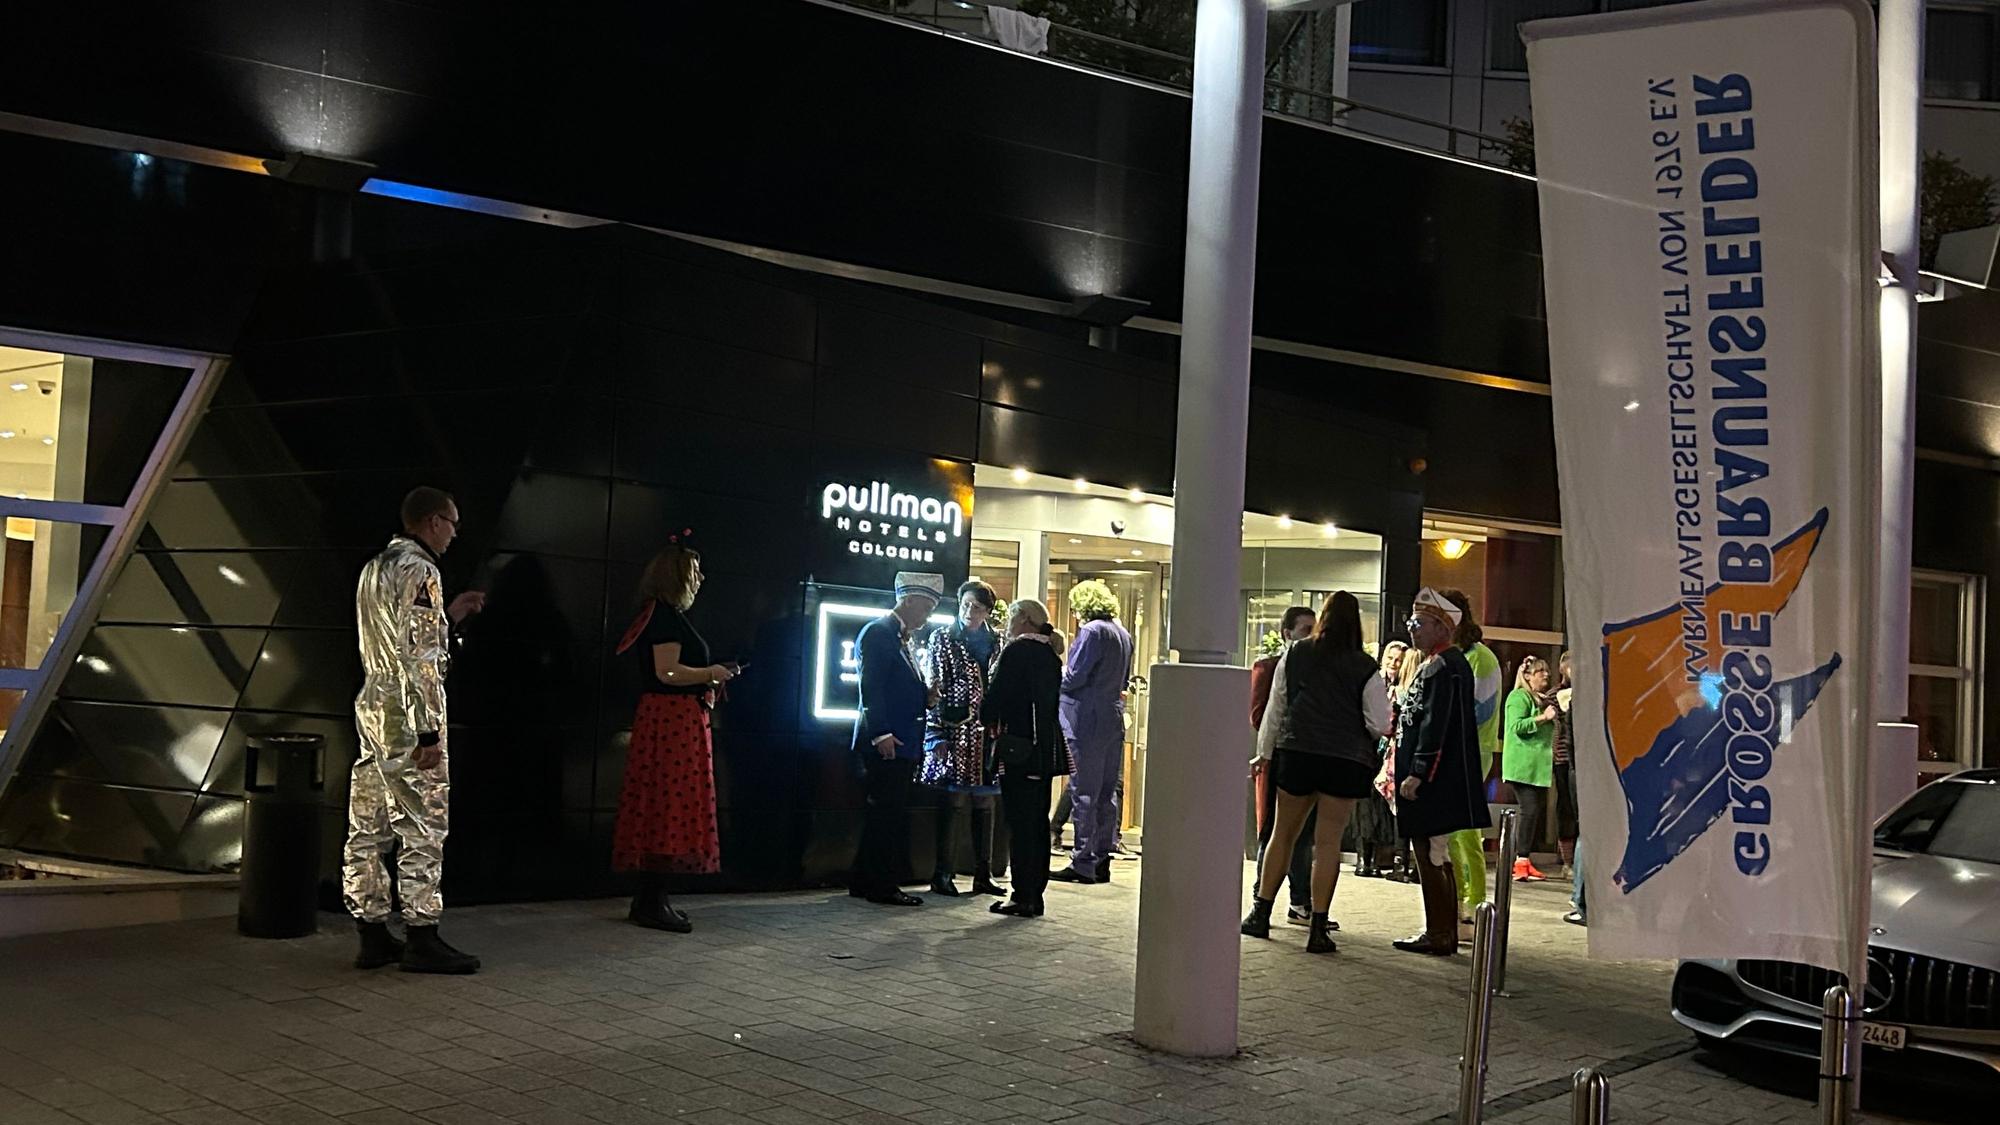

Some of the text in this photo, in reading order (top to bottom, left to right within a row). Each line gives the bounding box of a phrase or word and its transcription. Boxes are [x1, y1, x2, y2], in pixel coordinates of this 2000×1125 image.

[822, 481, 962, 537] pullman
[837, 517, 947, 543] HOTELS
[849, 540, 934, 562] COLOGNE
[1863, 1026, 1899, 1046] 2448
